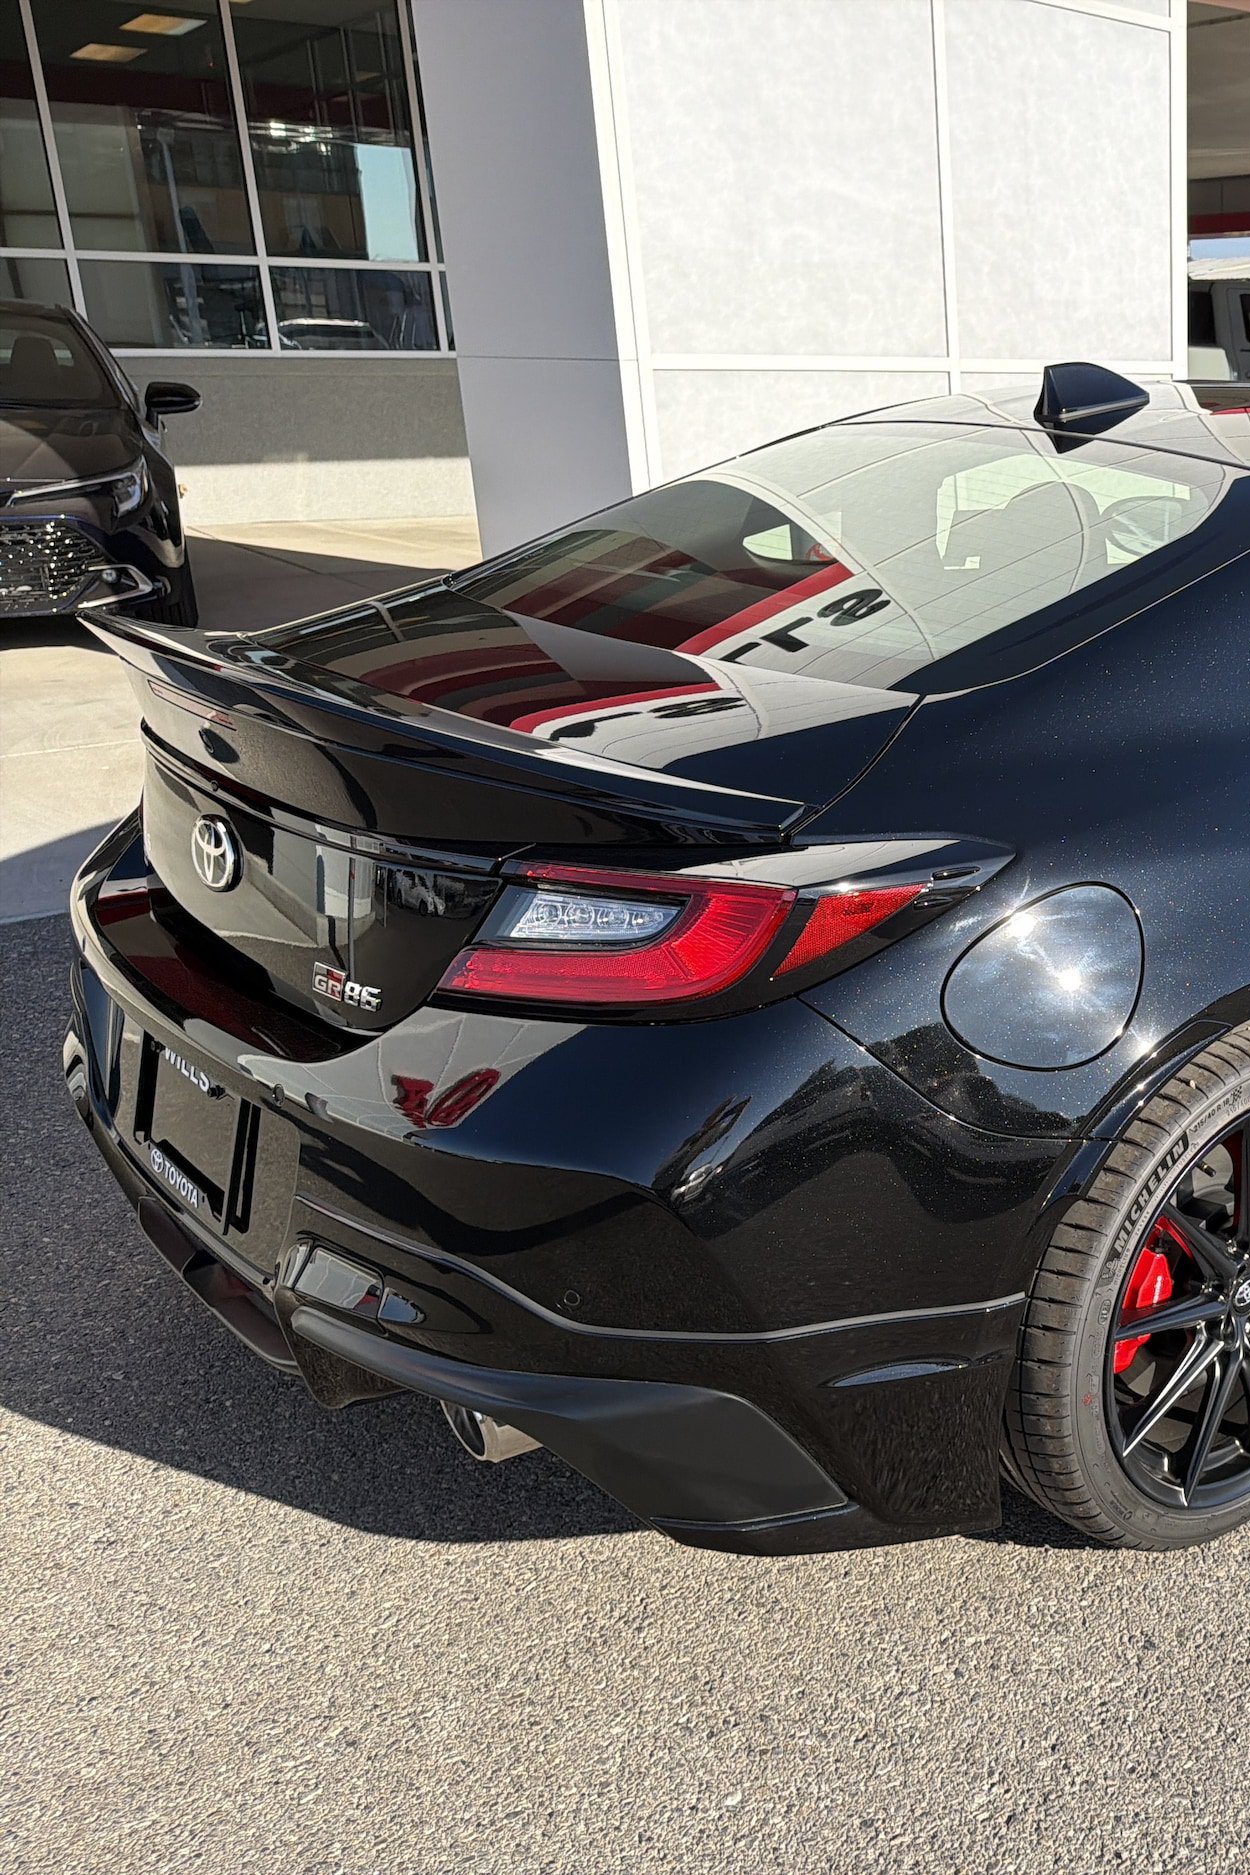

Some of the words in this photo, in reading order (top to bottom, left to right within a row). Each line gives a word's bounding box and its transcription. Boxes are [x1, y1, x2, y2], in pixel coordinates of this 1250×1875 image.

[164, 1160, 200, 1209] TOYOTA
[1113, 1137, 1187, 1255] MICHELIN
[1193, 1109, 1217, 1133] 215/40
